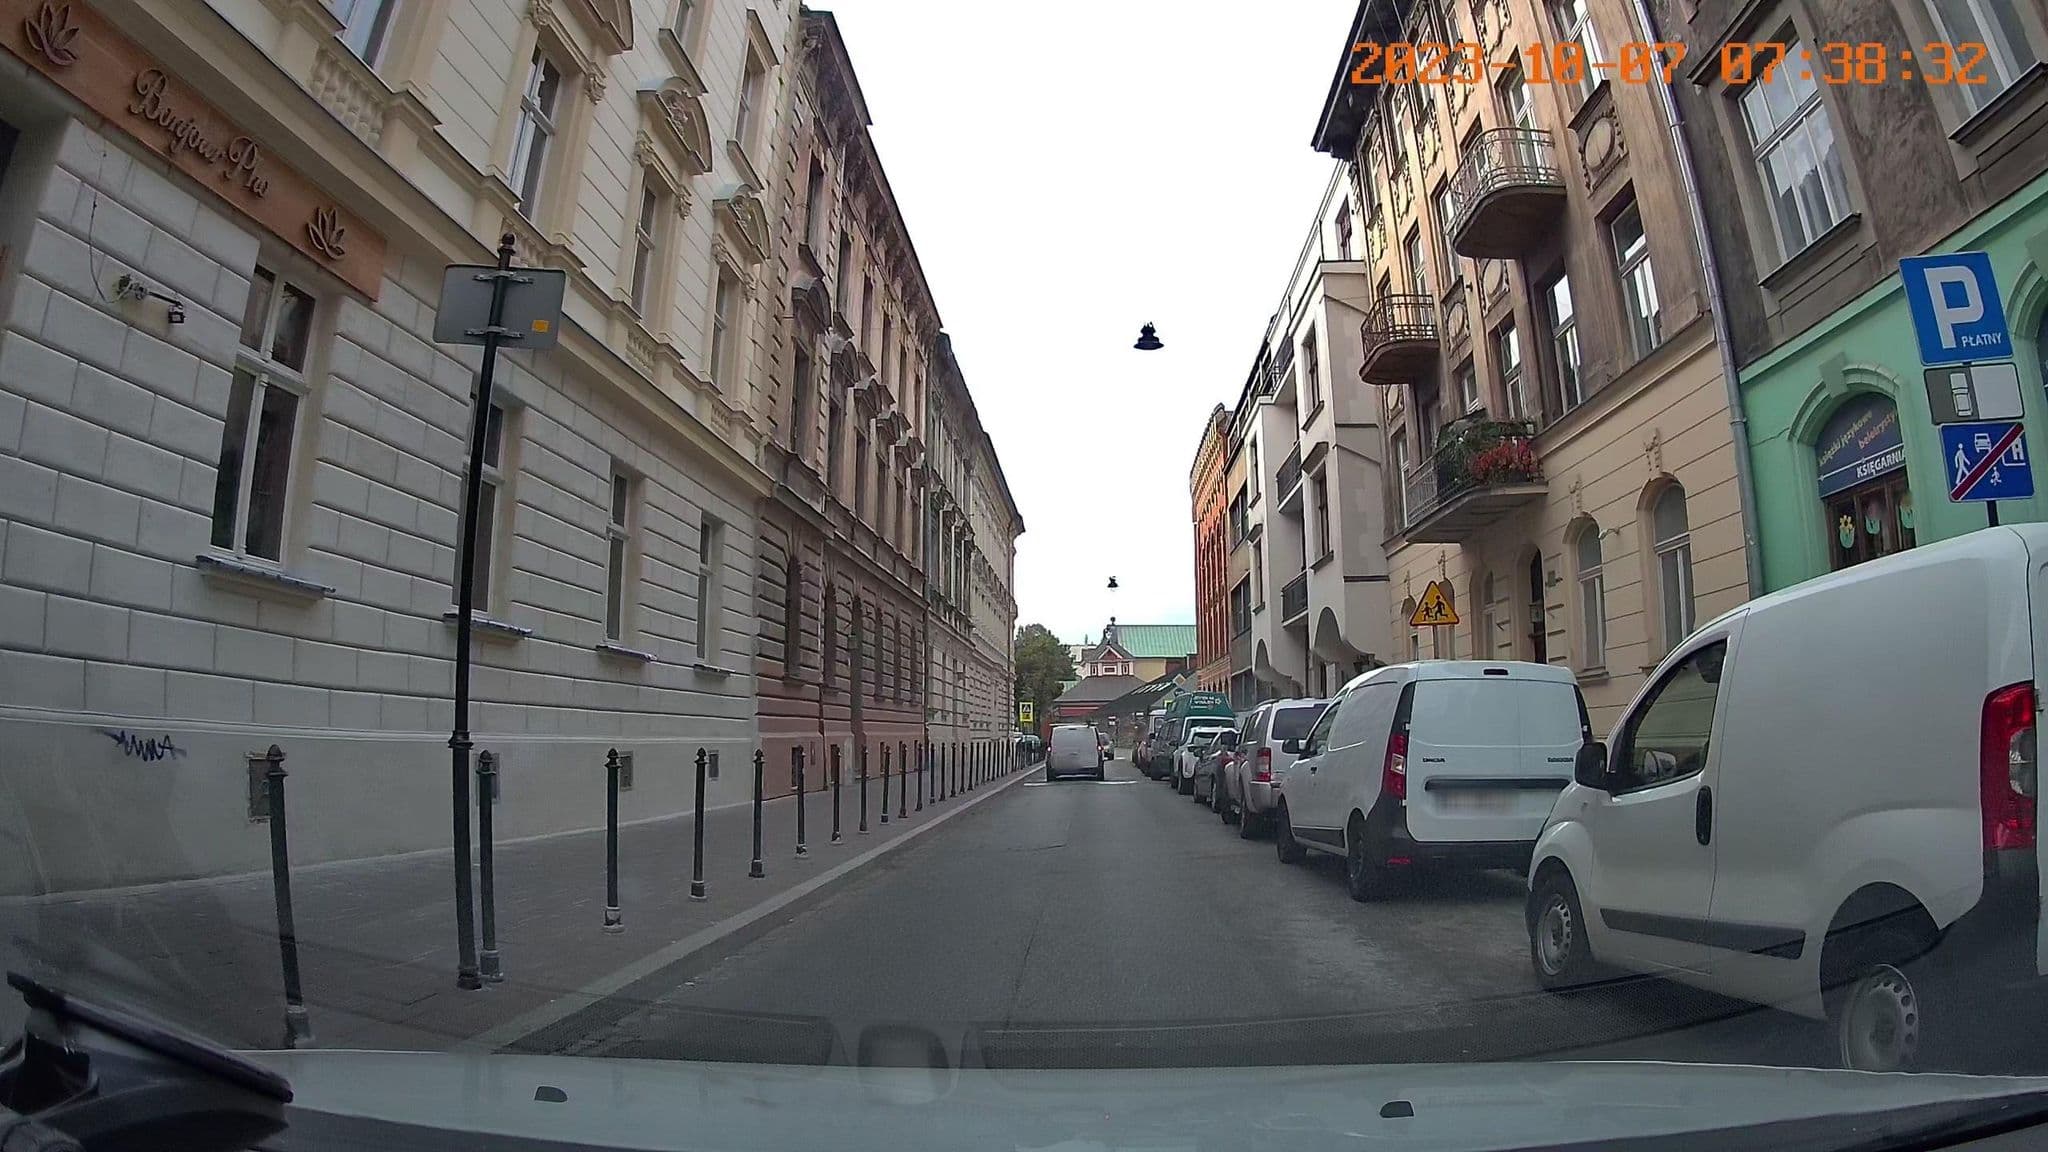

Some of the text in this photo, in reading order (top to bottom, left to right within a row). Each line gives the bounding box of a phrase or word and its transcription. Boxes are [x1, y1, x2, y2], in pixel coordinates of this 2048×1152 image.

[127, 68, 227, 164] Bonjour
[1923, 265, 1985, 349] P
[1961, 332, 2002, 348] PŁATNY
